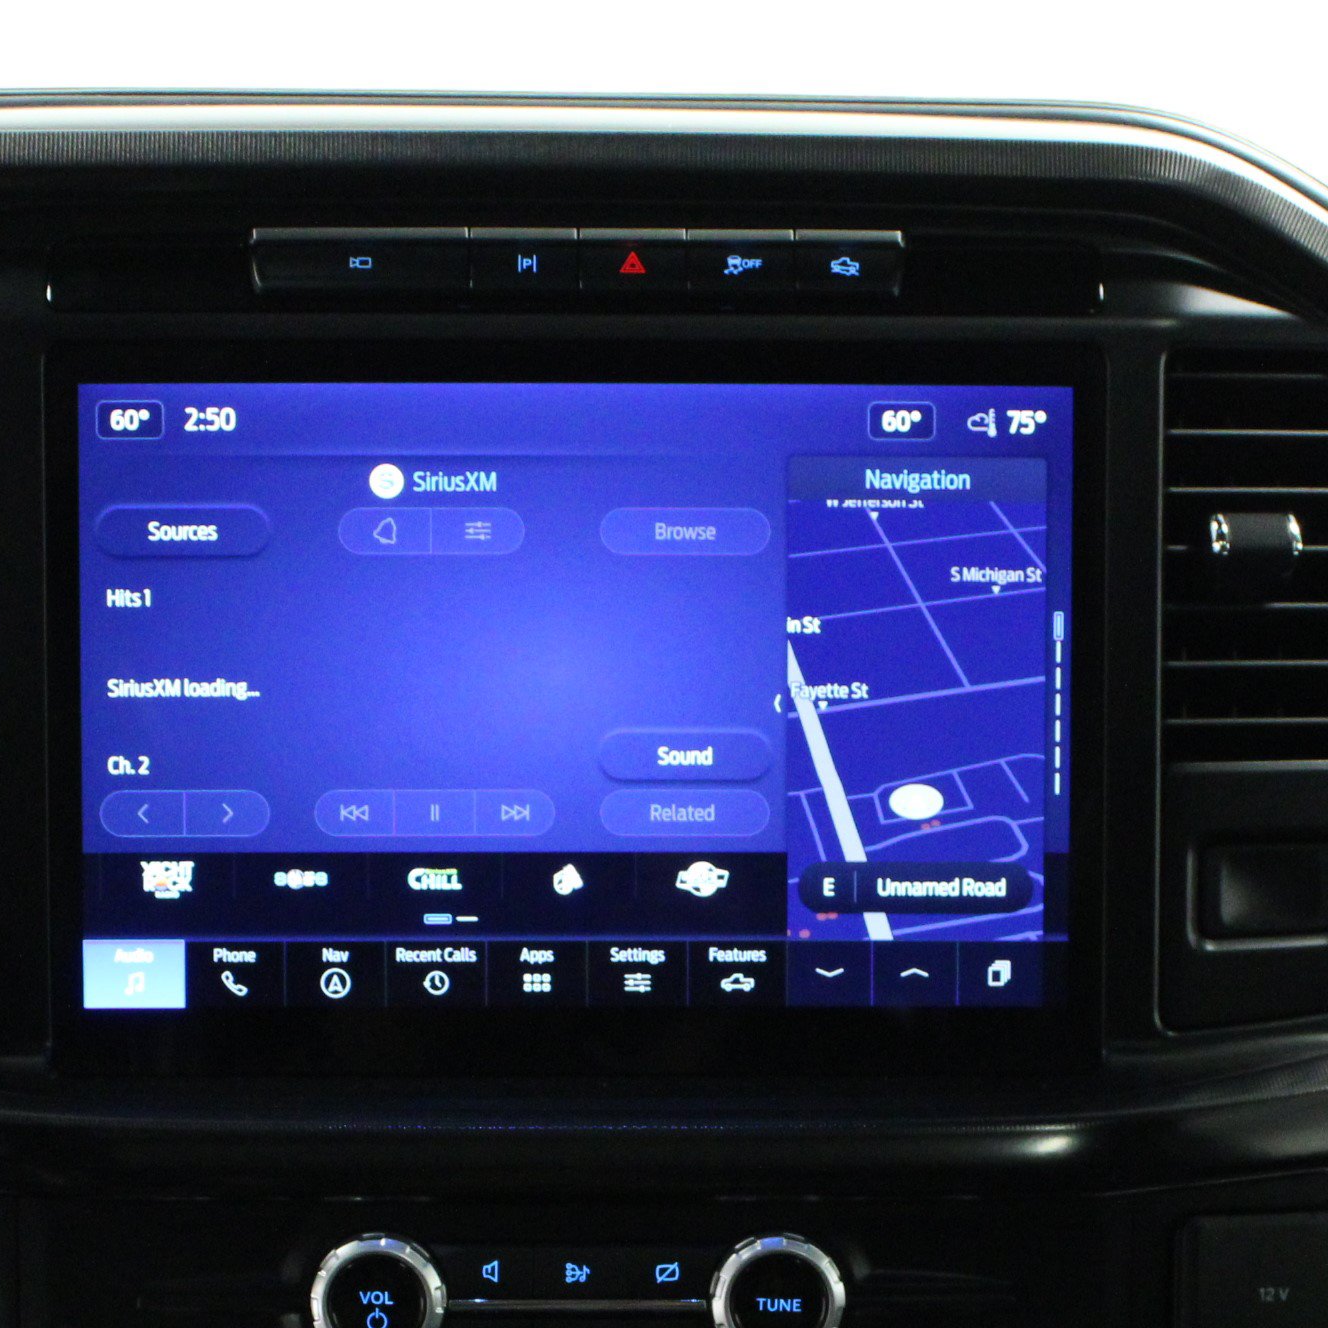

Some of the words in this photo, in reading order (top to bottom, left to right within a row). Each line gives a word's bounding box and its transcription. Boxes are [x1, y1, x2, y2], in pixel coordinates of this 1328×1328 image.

[742, 259, 762, 269] OFF
[110, 408, 150, 431] 60°
[184, 407, 236, 432] 2:50
[881, 410, 921, 432] 60°
[1006, 410, 1047, 434] 75°
[413, 471, 497, 492] SiriusXM
[865, 469, 971, 493] Navigation
[147, 521, 218, 543] Sources
[654, 521, 716, 541] Browse
[950, 567, 960, 582] S
[962, 567, 1023, 584] Michigan
[1026, 568, 1042, 582] St
[106, 588, 140, 608] Hits
[802, 618, 820, 633] St
[107, 679, 180, 698] SiriusXM
[852, 683, 869, 698] St
[107, 756, 135, 775] Ch.
[138, 756, 150, 775] 2
[657, 746, 713, 766] Sound
[650, 804, 715, 822] Related
[407, 868, 462, 890] CHILL
[823, 877, 835, 896] E
[877, 877, 959, 897] Unnamed
[962, 877, 1006, 896] Road
[213, 948, 256, 963] Phone
[322, 948, 349, 962] Nav
[396, 948, 442, 962] Recent
[444, 948, 477, 962] Calls
[520, 948, 554, 964] Apps
[610, 948, 665, 965] Settings
[709, 948, 767, 962] Features
[359, 1291, 394, 1305] VOL
[756, 1298, 801, 1312] TUNE
